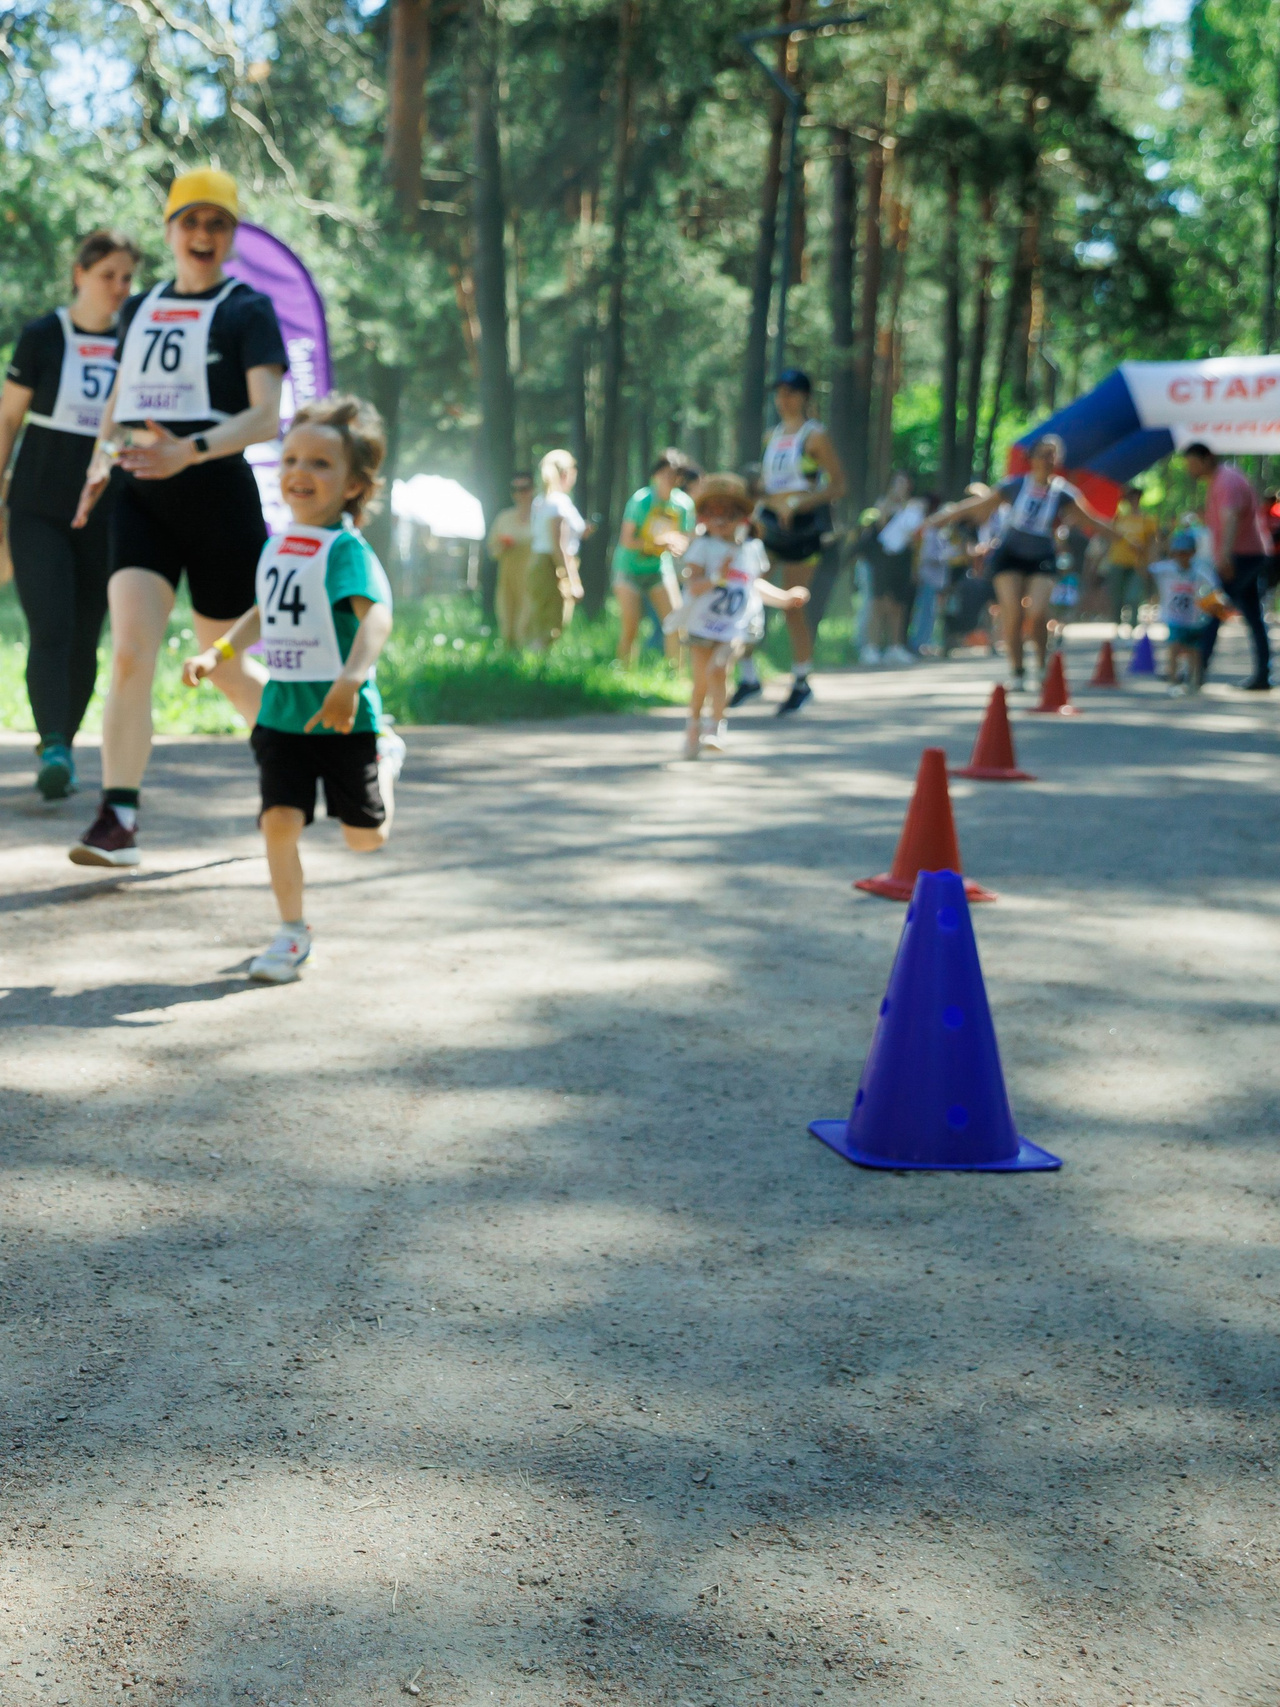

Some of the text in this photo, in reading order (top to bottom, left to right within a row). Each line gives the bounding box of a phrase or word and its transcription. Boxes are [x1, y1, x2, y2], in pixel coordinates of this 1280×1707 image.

[141, 328, 185, 373] 76
[83, 365, 117, 402] 57
[266, 566, 306, 626] 24
